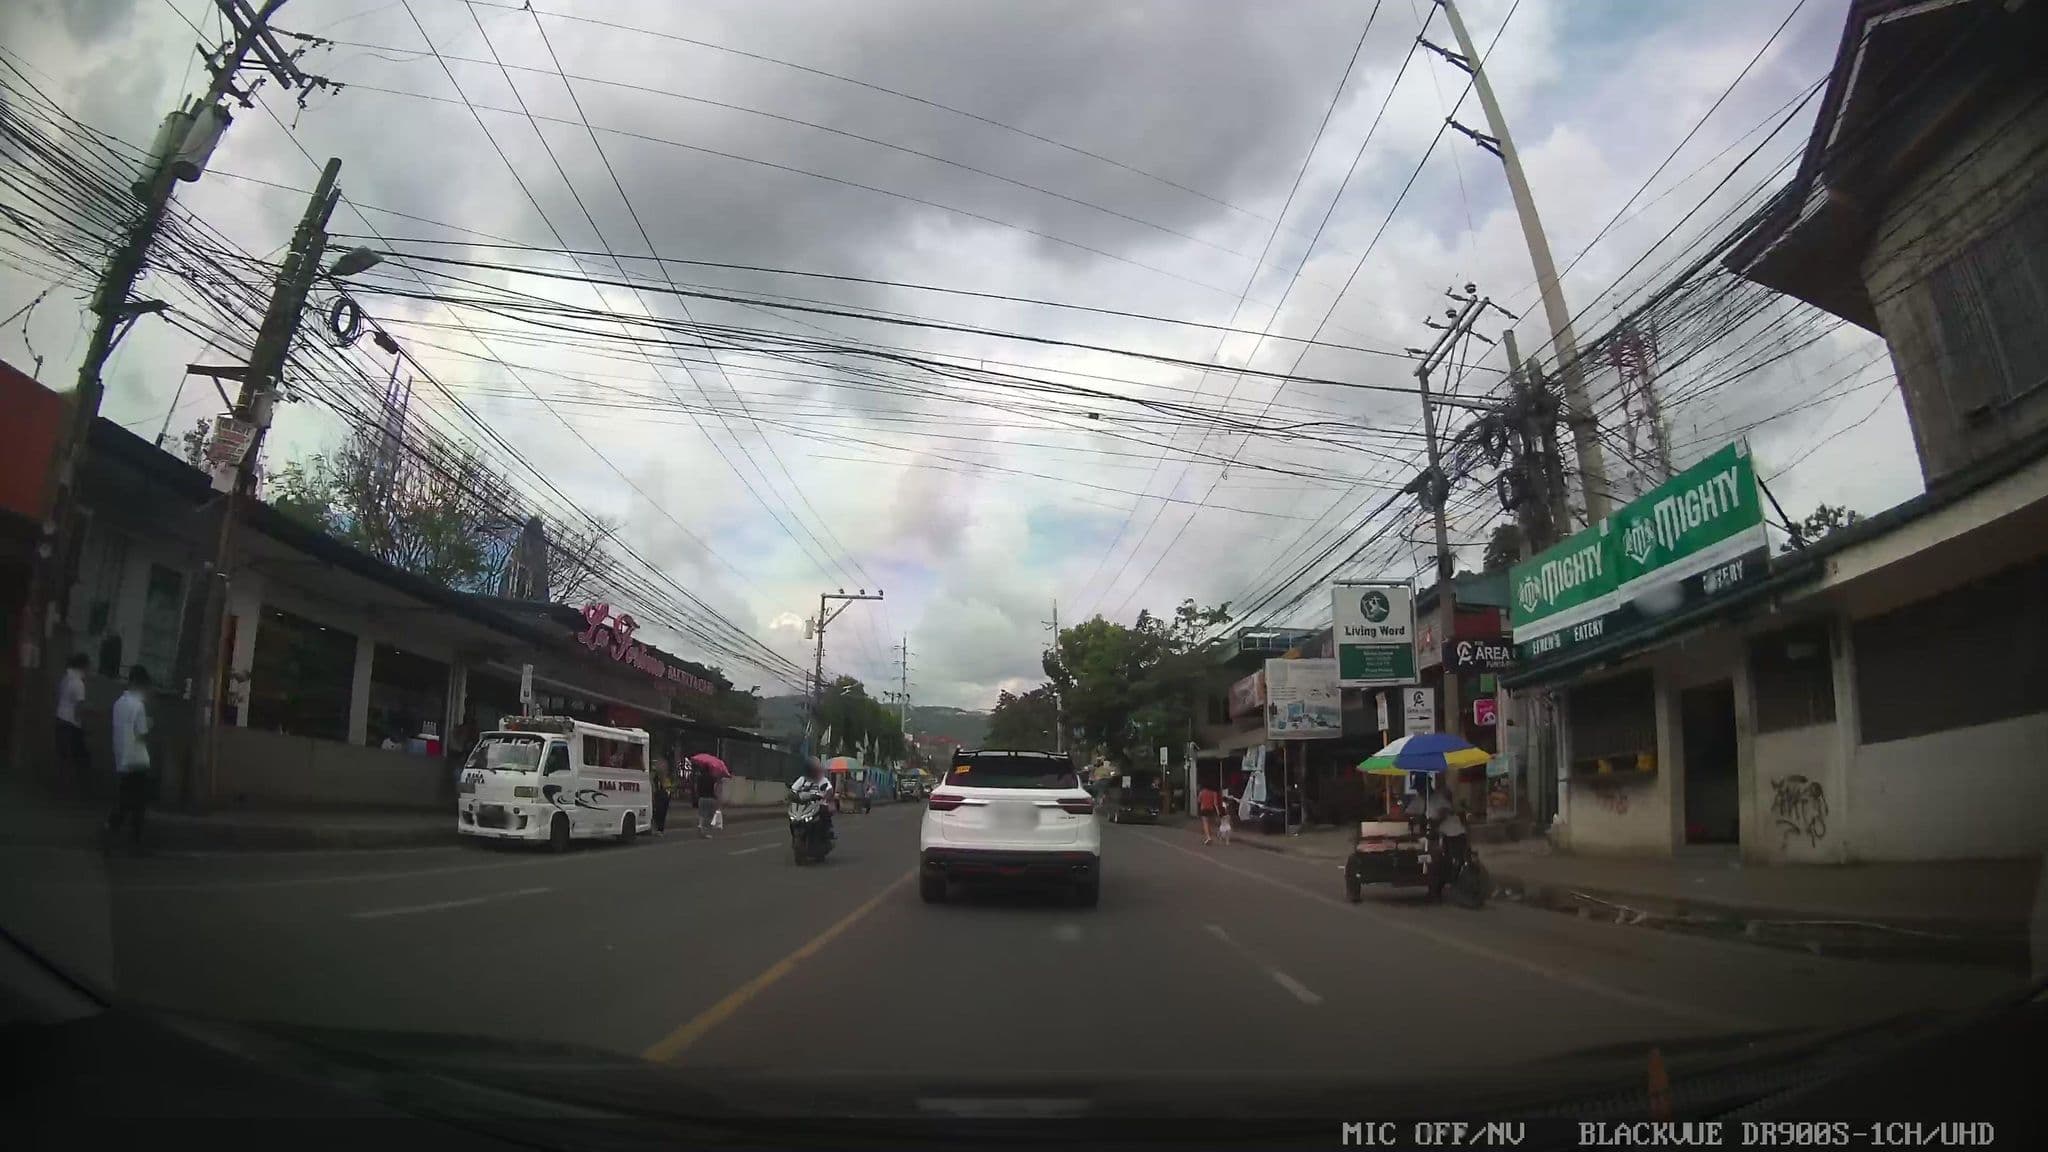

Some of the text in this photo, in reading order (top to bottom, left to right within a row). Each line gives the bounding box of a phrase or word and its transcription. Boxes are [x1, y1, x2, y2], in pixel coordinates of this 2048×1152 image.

[1654, 466, 1740, 552] MIGHTY
[1541, 541, 1602, 605] MIGHTY
[1345, 625, 1405, 637] Living Word
[1574, 618, 1603, 642] EATERY
[1475, 646, 1510, 660] AREA
